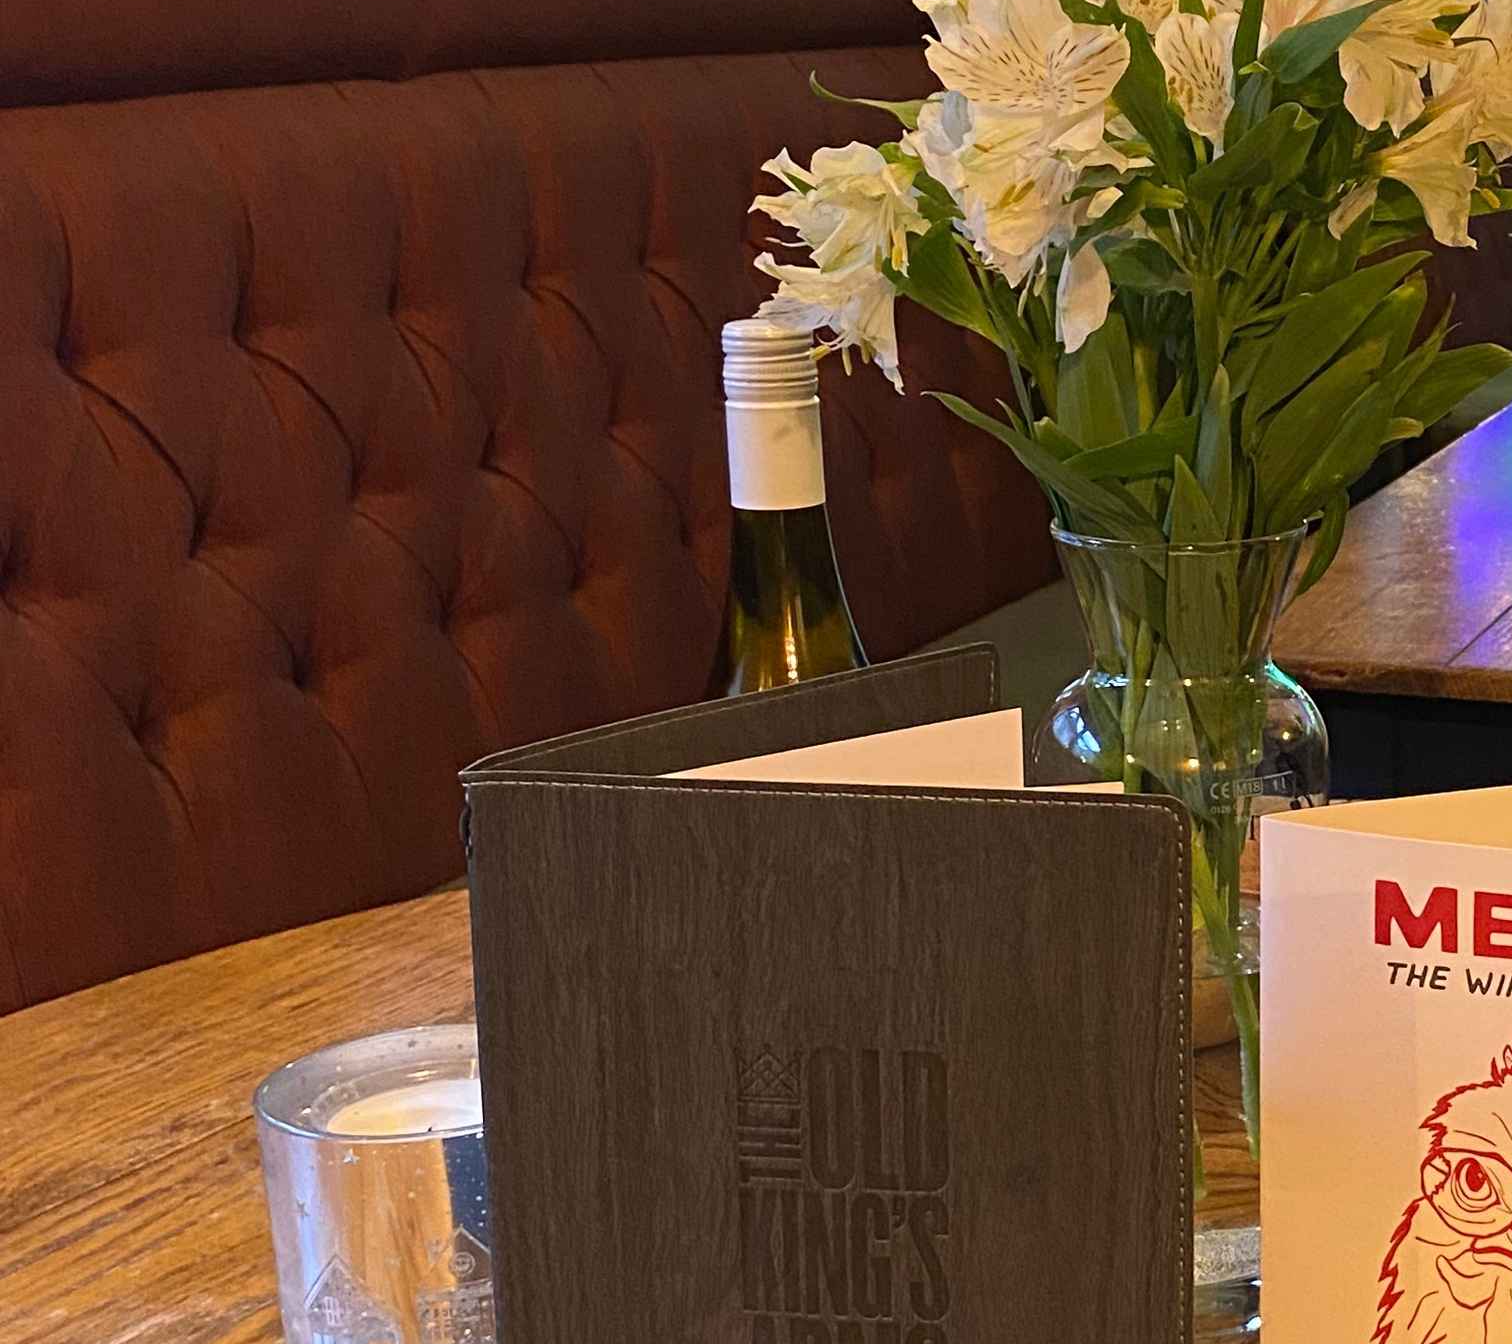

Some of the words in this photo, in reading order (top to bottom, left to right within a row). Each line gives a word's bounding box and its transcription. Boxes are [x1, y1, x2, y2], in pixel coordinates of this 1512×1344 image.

[1387, 961, 1450, 990] THE
[806, 1046, 950, 1193] OLD
[738, 1188, 950, 1323] KING'S
